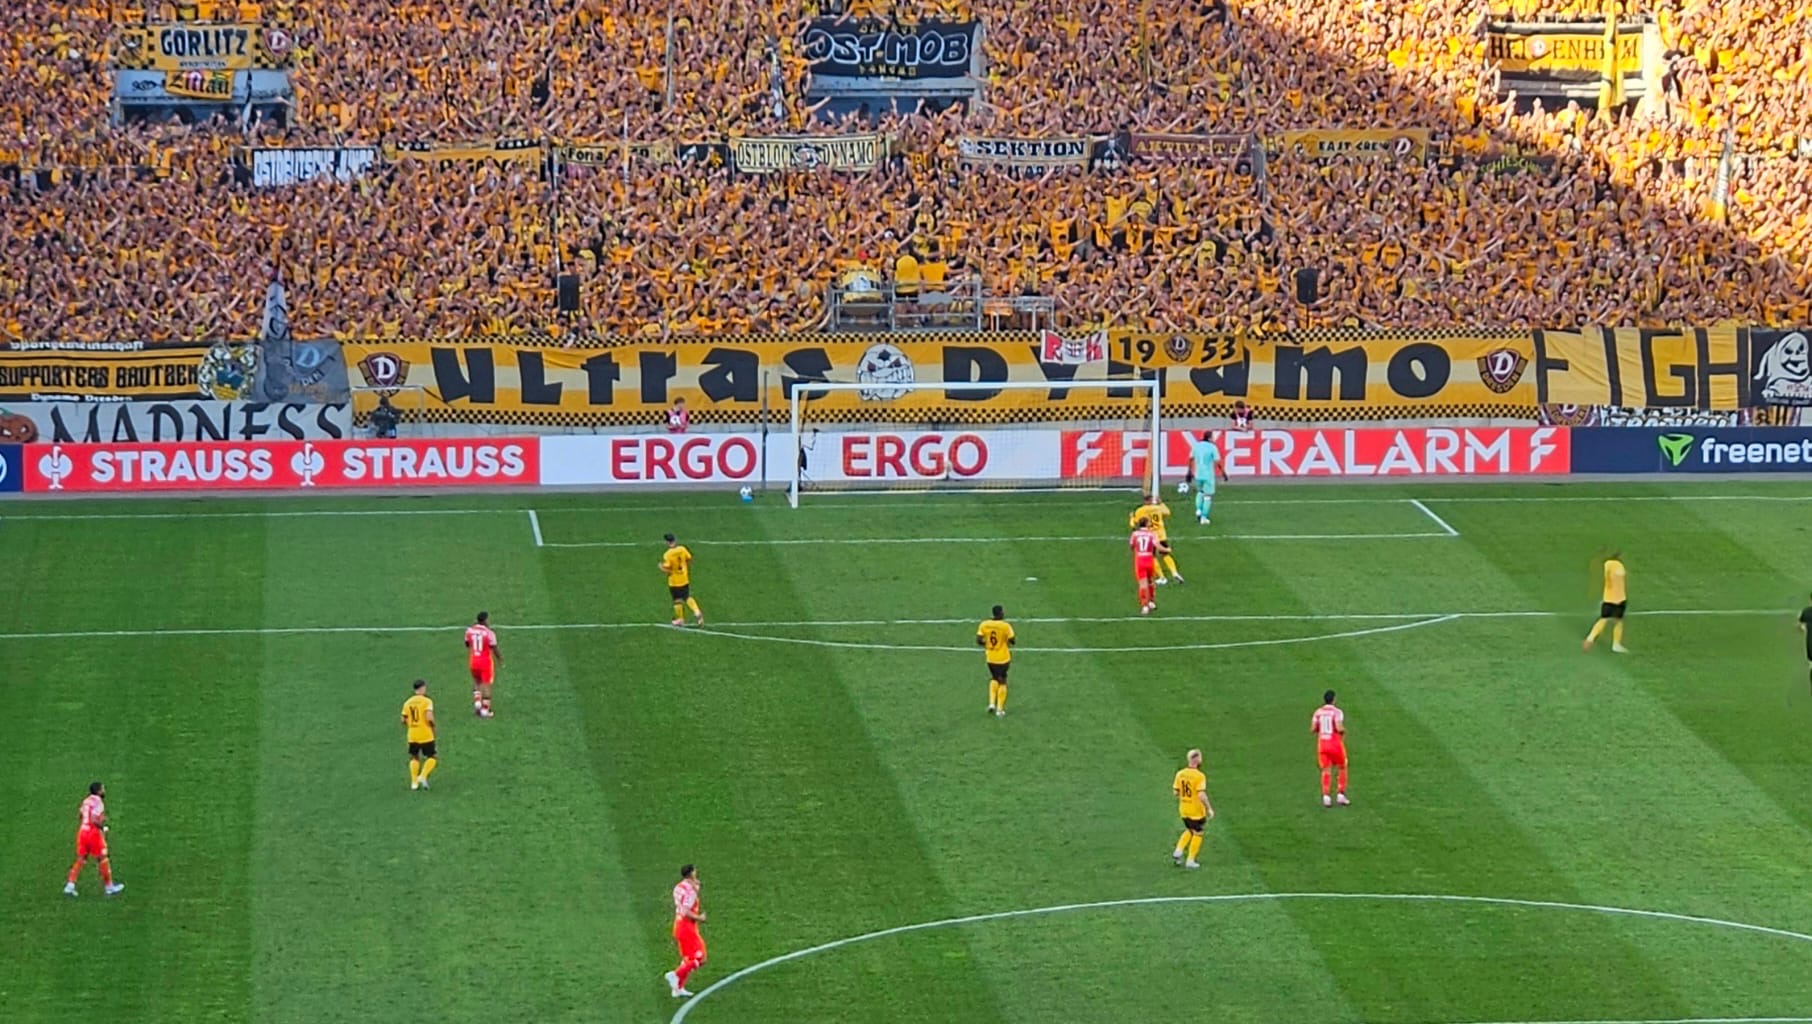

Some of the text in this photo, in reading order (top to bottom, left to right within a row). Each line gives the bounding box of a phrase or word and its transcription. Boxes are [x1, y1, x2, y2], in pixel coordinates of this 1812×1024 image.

[885, 31, 968, 66] MOB
[976, 140, 1085, 157] SEKTION
[1119, 336, 1156, 363] 19
[1201, 336, 1236, 364] 53
[0, 365, 109, 388] SUPPORTERS
[51, 403, 350, 444] MADNESS
[91, 449, 273, 482] STRAUSS
[343, 445, 525, 480] STRAUSS
[611, 437, 757, 480] ERGO
[842, 435, 988, 477] ERGO
[1701, 437, 1812, 464] freenet
[990, 630, 998, 648] 6
[1181, 780, 1192, 798] 16
